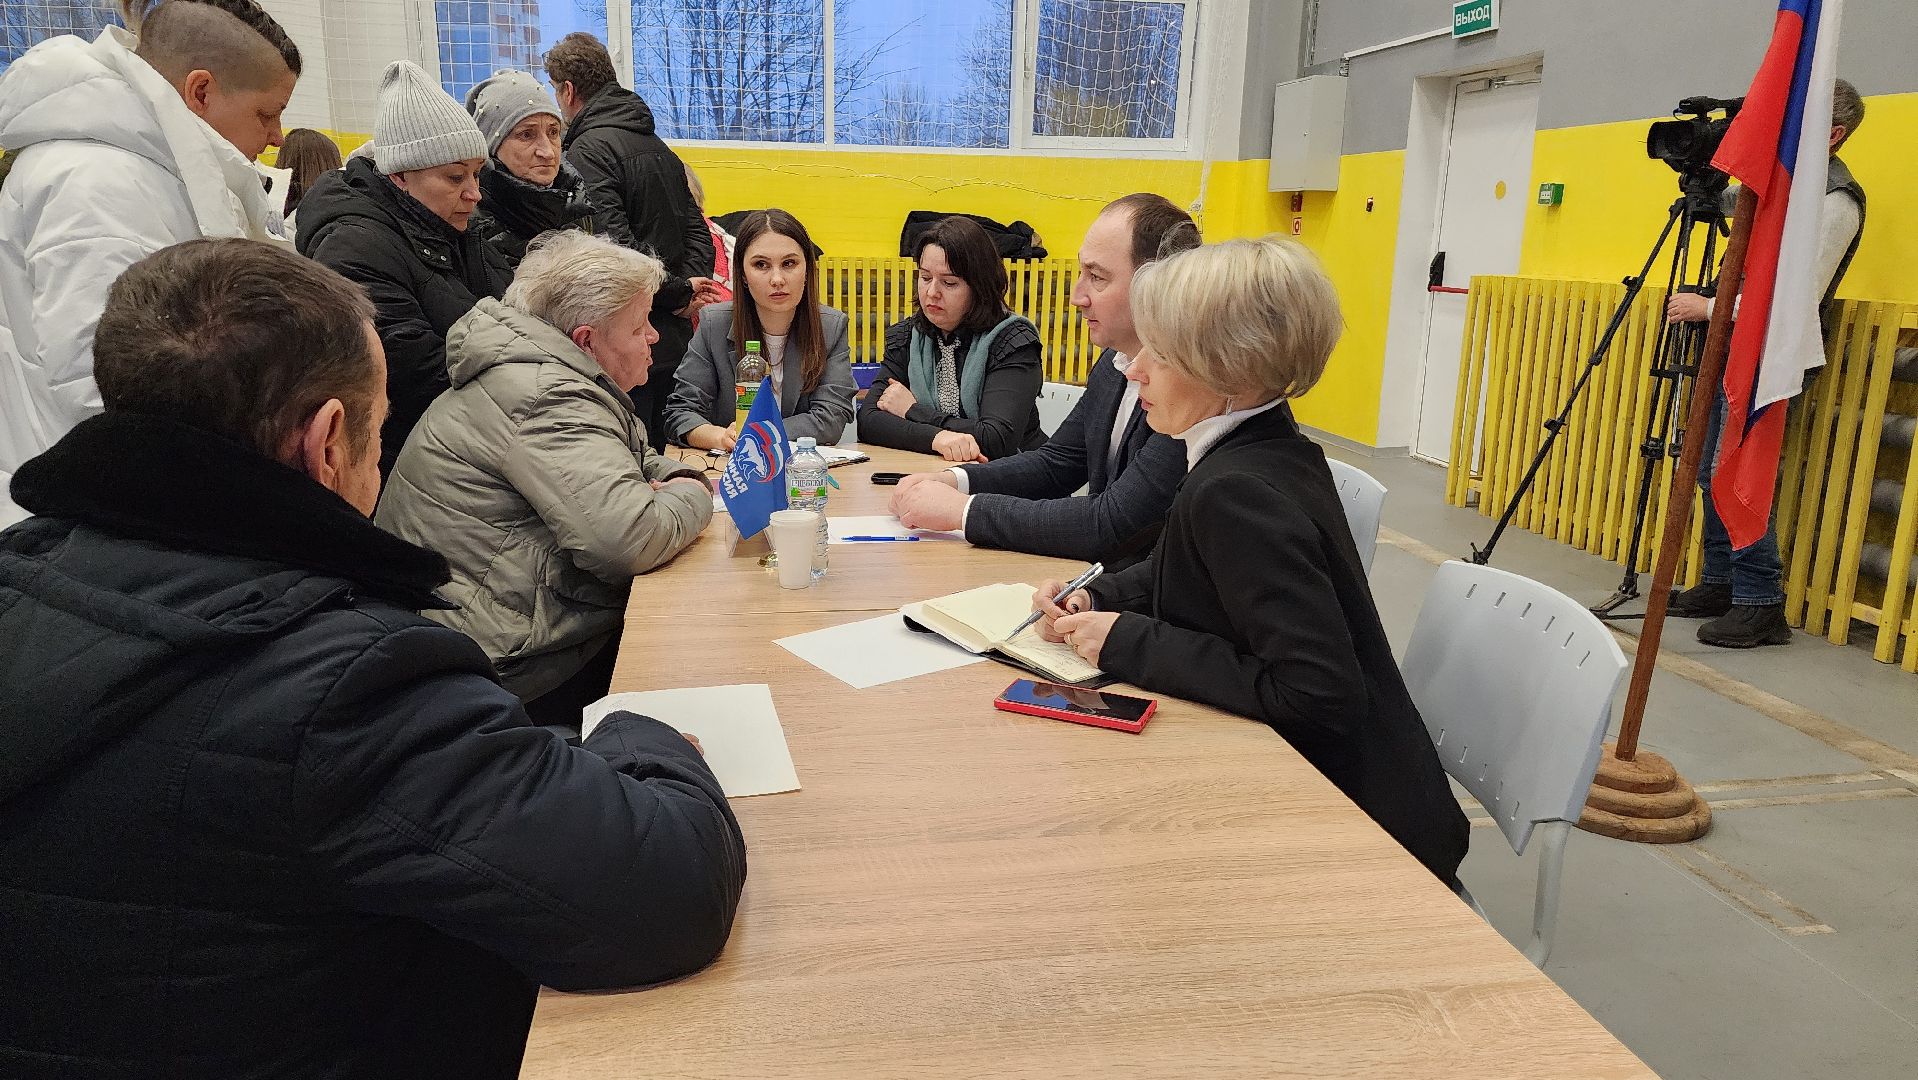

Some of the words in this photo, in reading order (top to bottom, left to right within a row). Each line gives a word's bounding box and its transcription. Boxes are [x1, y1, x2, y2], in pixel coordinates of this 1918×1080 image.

[1455, 5, 1490, 27] ВЫХОД
[722, 470, 739, 499] СИЯ
[728, 458, 748, 494] ИНАЯ
